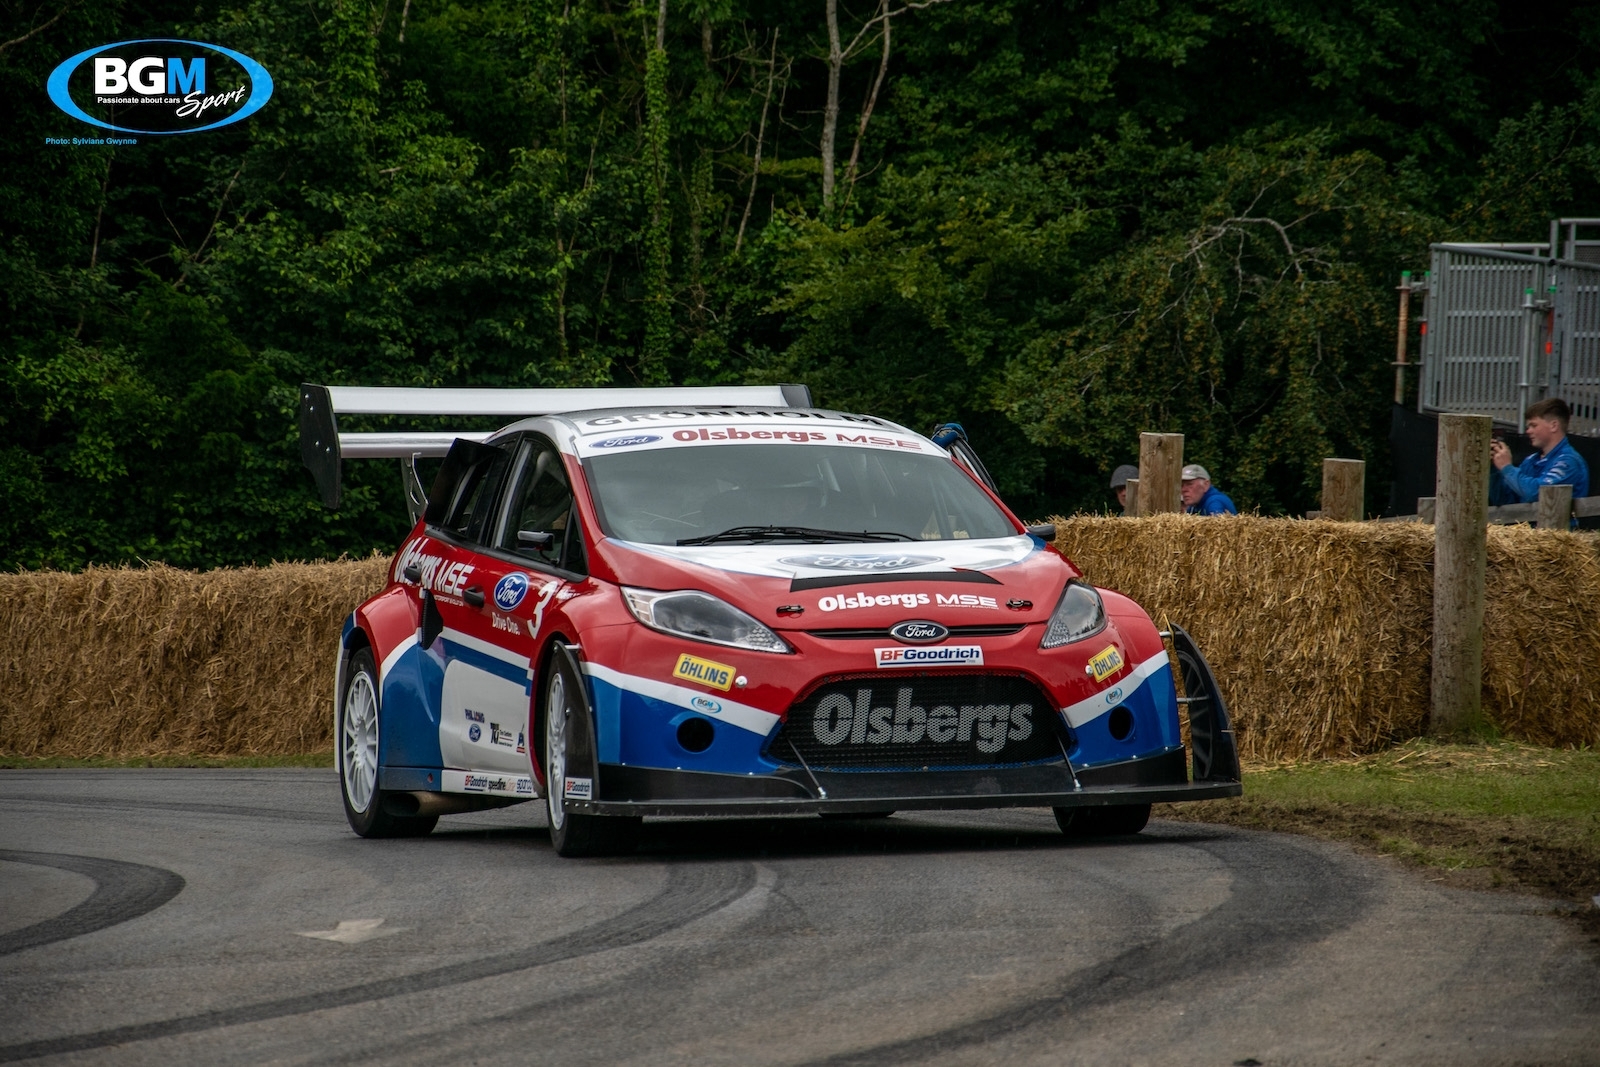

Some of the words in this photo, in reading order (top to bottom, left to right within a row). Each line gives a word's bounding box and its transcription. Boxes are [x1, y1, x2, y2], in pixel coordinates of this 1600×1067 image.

[603, 437, 649, 448] Ford
[673, 427, 827, 443] Olsbergs
[836, 433, 922, 450] MSE
[815, 556, 909, 570] Ford
[434, 560, 475, 598] MSE
[497, 577, 523, 605] Ford
[527, 581, 558, 640] 3
[818, 592, 931, 611] Olsbergs
[935, 593, 998, 608] MSE
[905, 623, 937, 638] Ford
[880, 648, 980, 662] BFGoodrich
[1092, 651, 1121, 677] ÖHLINS
[679, 657, 729, 685] ÖHLINS
[697, 698, 714, 708] BGM
[812, 687, 1033, 753] Olsbergs
[465, 775, 488, 788] BFGoodrich
[566, 780, 590, 792] BFGoodrich
